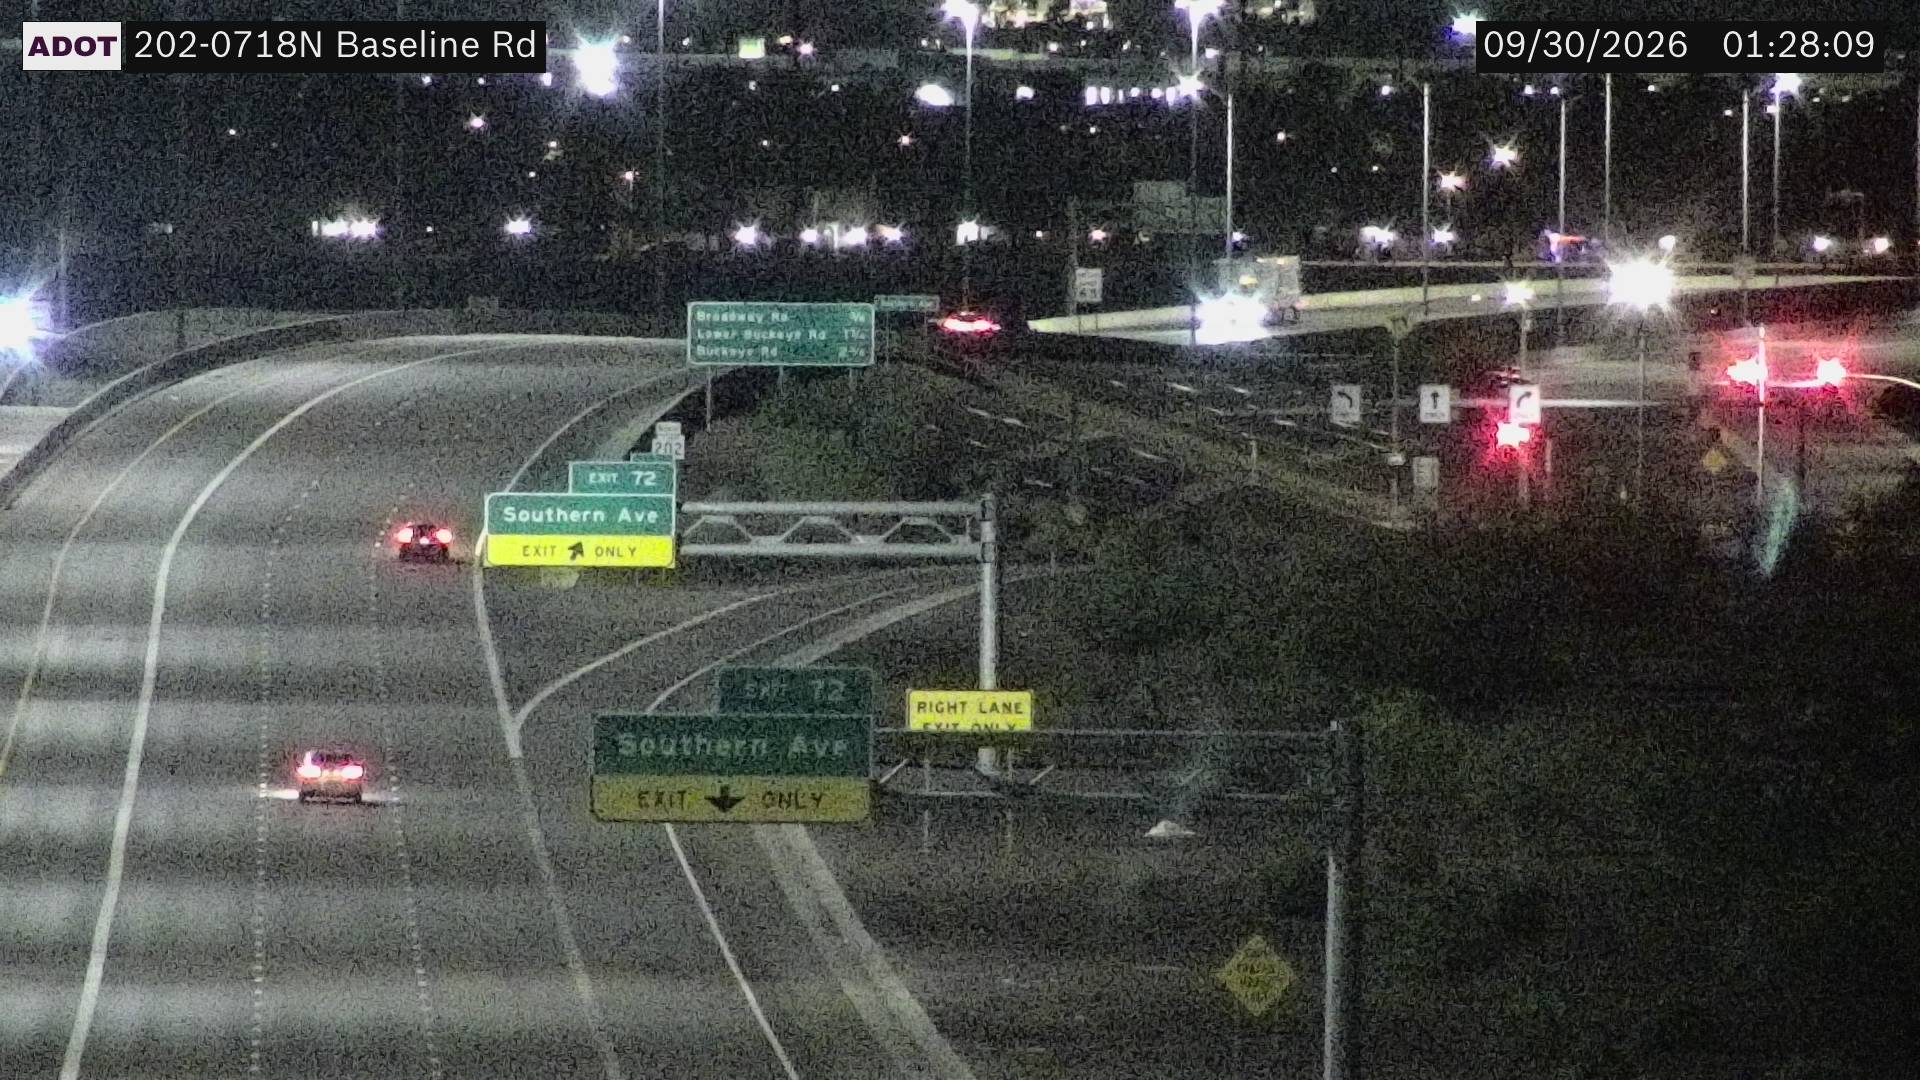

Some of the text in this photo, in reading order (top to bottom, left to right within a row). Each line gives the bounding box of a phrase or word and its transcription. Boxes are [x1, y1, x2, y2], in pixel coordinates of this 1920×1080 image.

[696, 310, 764, 324] Broadway
[697, 329, 737, 340] Lower
[743, 329, 802, 342] Buckeye
[809, 329, 827, 340] Rd
[696, 345, 754, 359] Buckeye
[761, 346, 778, 357] Rd
[589, 471, 657, 486] EXIT 72
[503, 507, 659, 524] Southern Ave
[522, 545, 638, 558] EXIT ONLY
[917, 701, 1024, 715] RIGHT LANE
[617, 733, 850, 758] Southern Ave
[637, 790, 826, 810] EXIT ONLY
